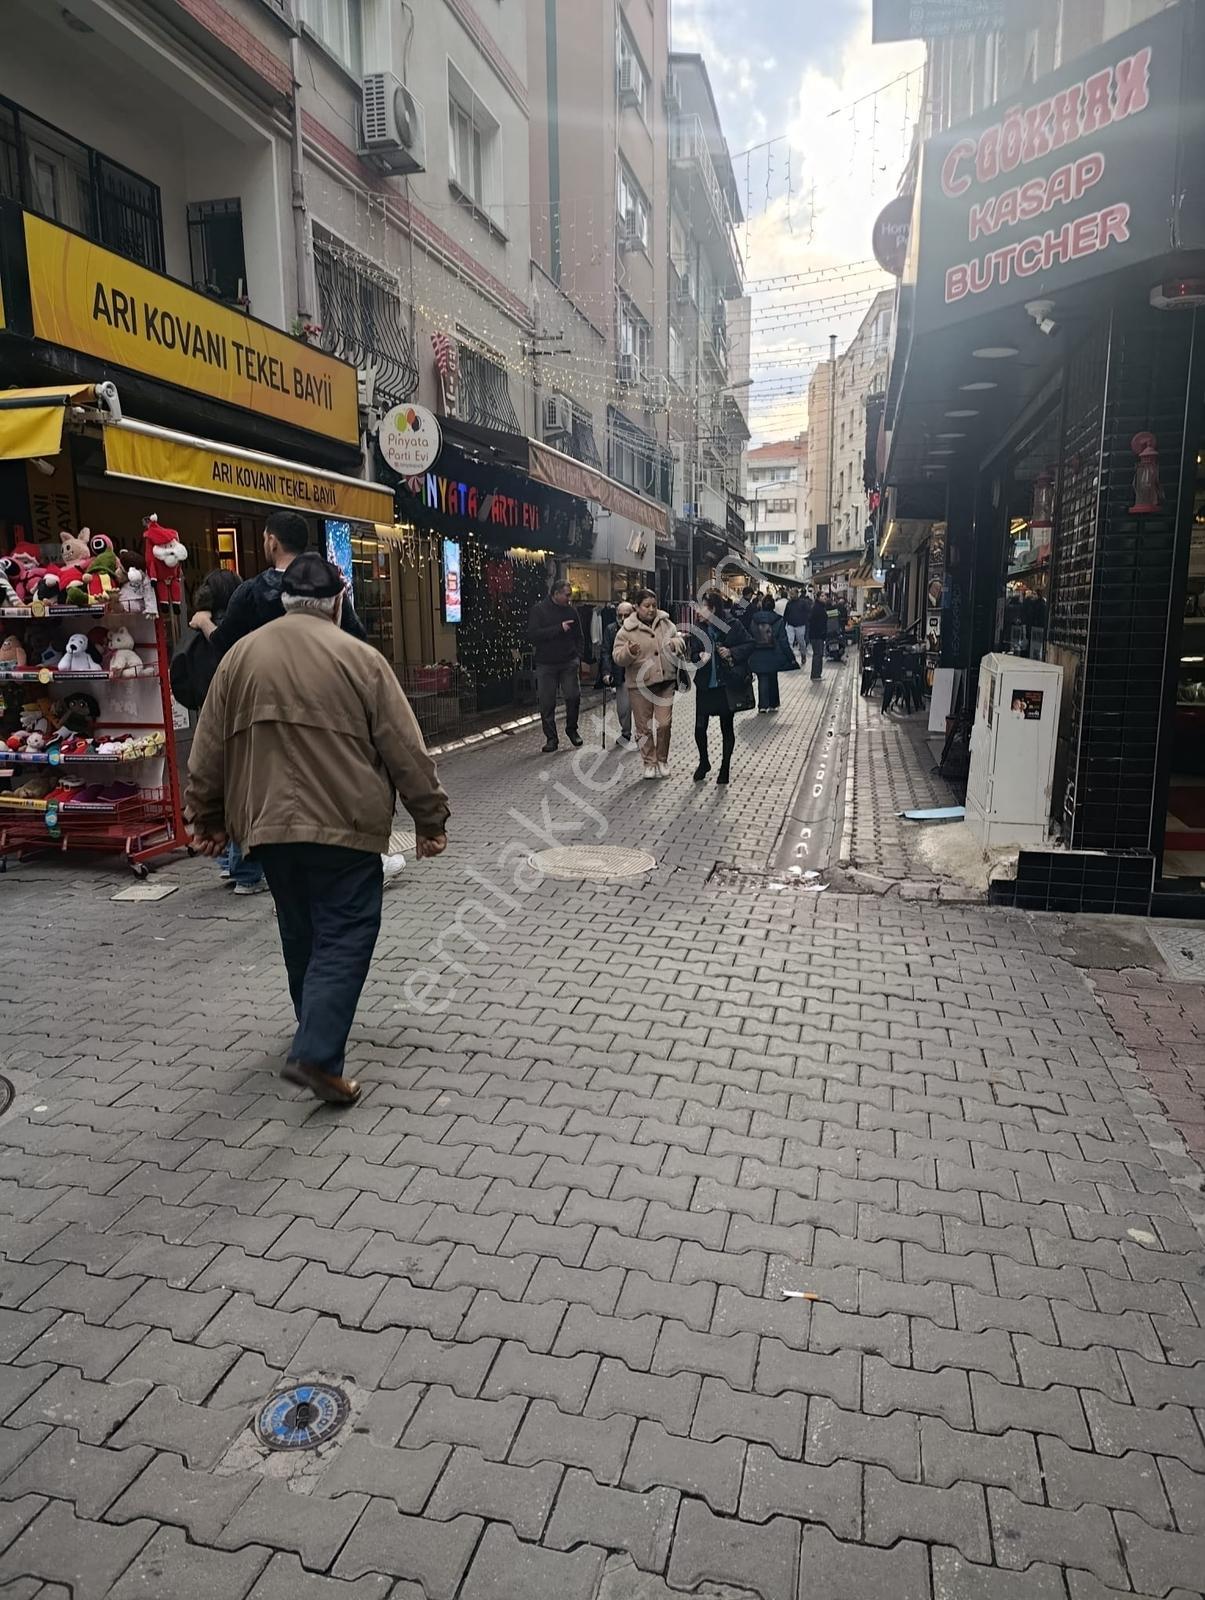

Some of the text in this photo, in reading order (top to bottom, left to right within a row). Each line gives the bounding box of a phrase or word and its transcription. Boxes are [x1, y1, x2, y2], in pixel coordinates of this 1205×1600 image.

[969, 152, 1104, 242] KASAP
[945, 202, 1130, 303] BUTCHER
[93, 282, 138, 336] ARI
[144, 302, 227, 370] KOVANI
[232, 341, 290, 395] TEKEL
[388, 433, 429, 448] Pinyata
[388, 448, 429, 462] Parti Evi
[212, 461, 233, 485] ARI
[236, 466, 277, 494] KOVANI
[279, 477, 312, 501] TEKEL
